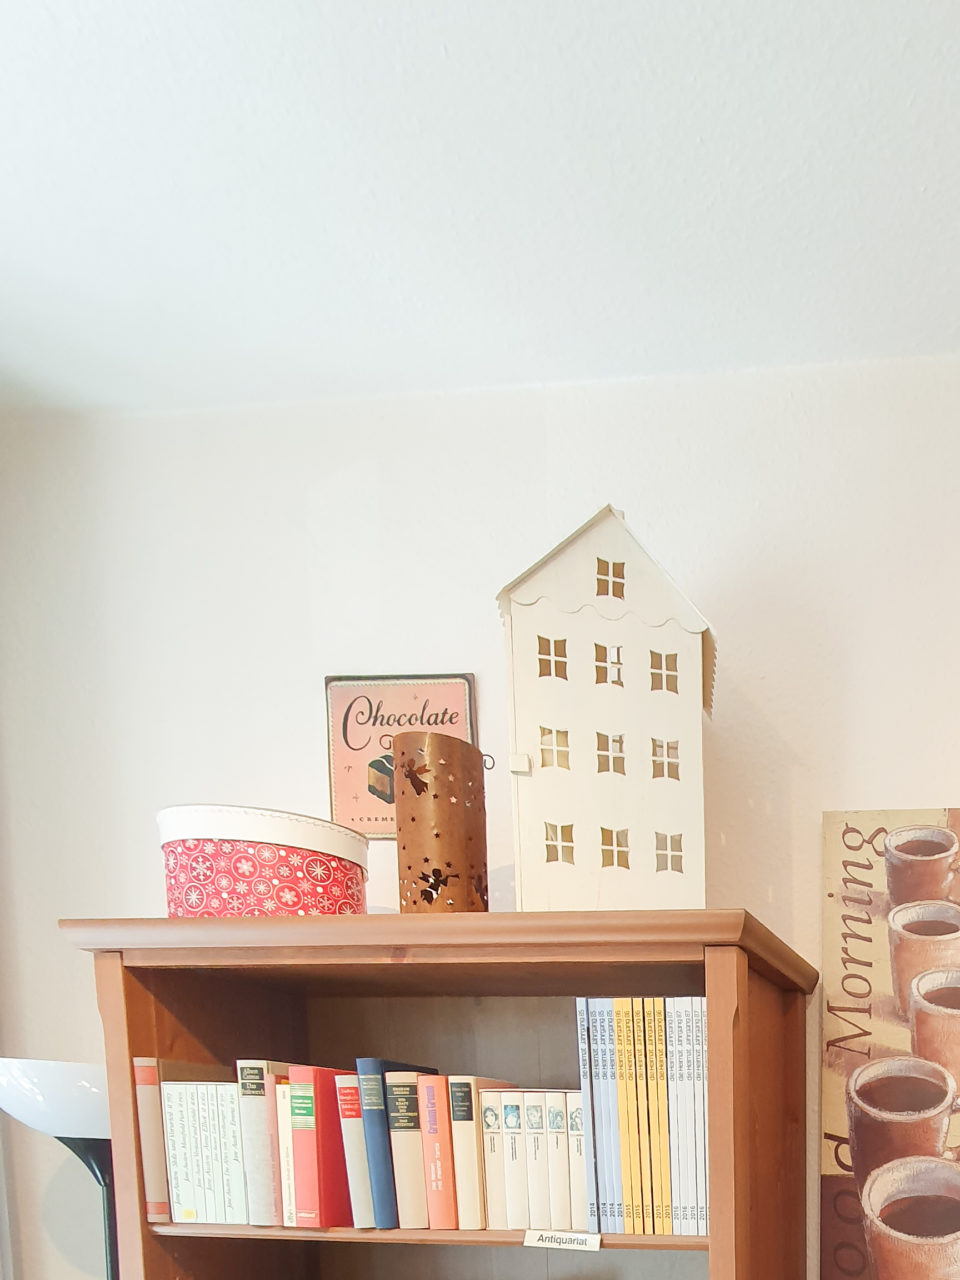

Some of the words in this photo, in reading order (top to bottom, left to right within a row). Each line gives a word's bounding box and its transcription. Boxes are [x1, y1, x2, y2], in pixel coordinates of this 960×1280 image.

[341, 695, 460, 751] Chocolate
[825, 821, 889, 1058] Morning
[537, 1234, 588, 1247] Antiquariat
